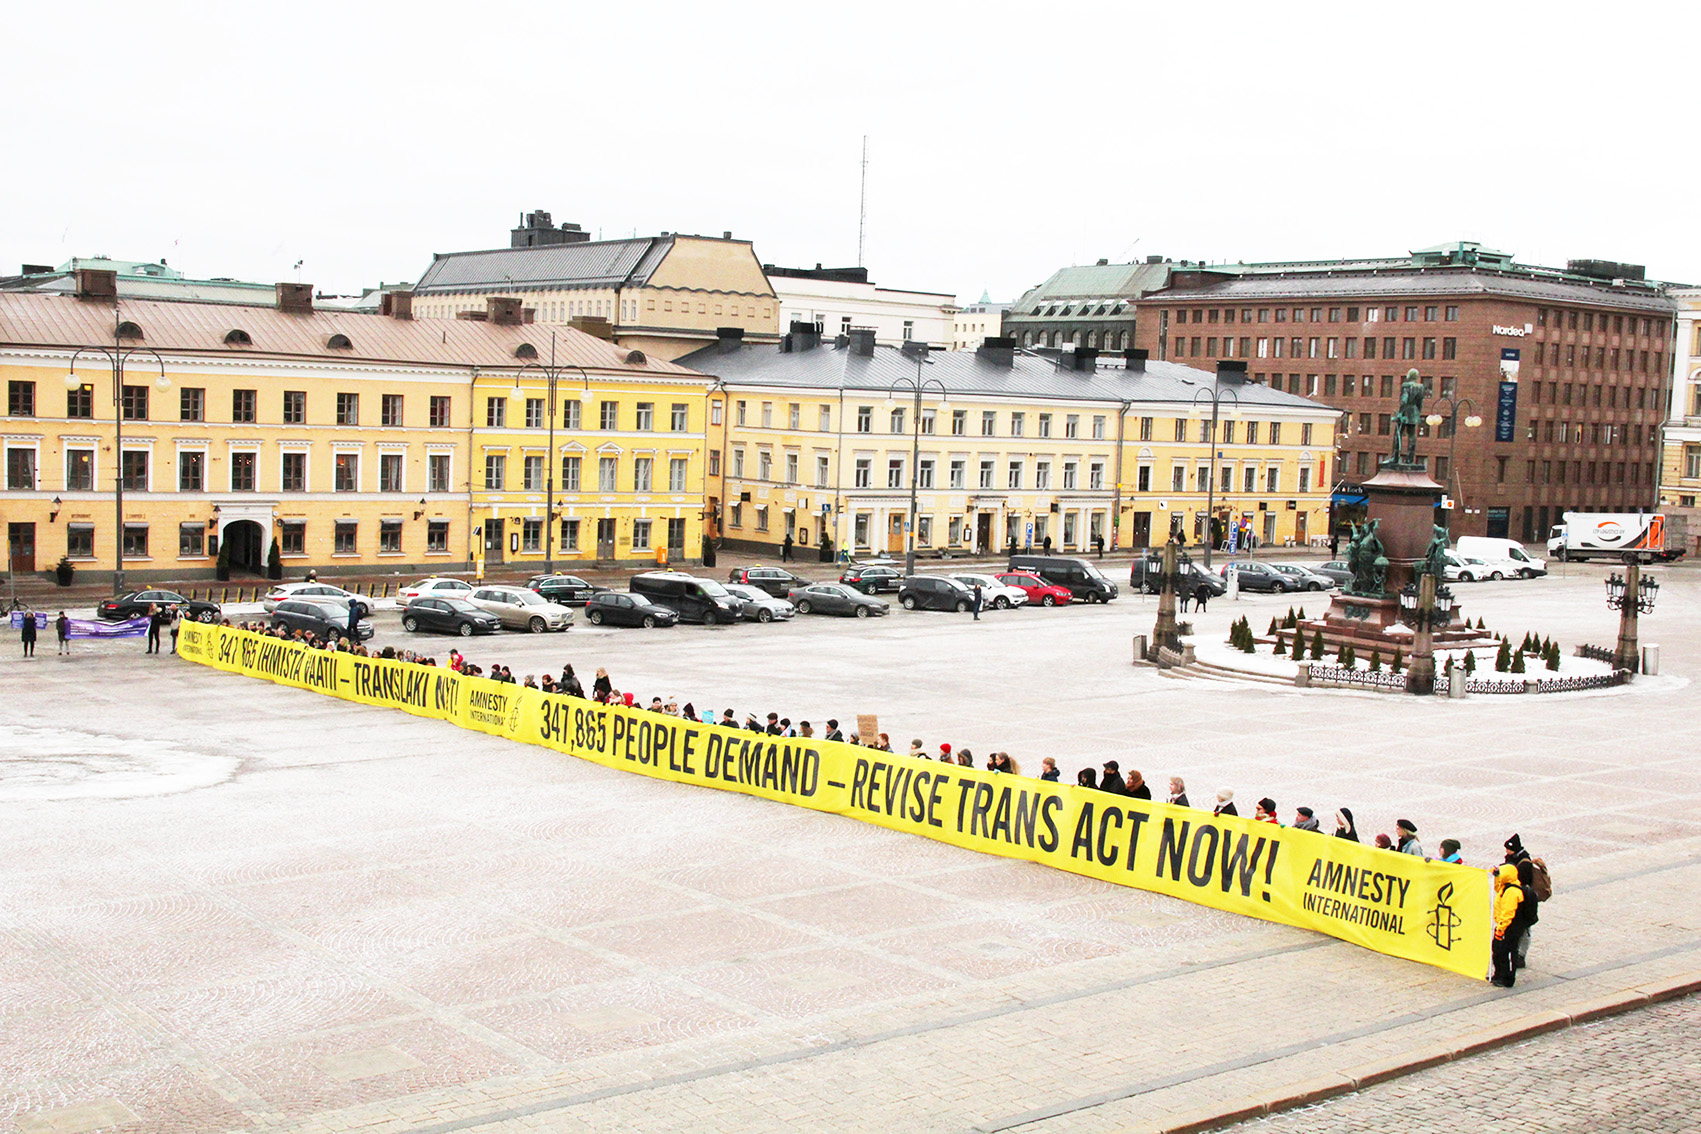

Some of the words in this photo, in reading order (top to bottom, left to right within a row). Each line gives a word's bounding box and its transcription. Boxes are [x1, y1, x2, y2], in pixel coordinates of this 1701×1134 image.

[1492, 325, 1525, 337] Nordea
[218, 633, 239, 665] 347
[257, 642, 308, 680] IHMISTÄ
[304, 654, 338, 691] VAATII
[353, 662, 430, 708] TRANSLAKI
[435, 675, 460, 716] NYT!
[469, 690, 508, 713] AMNESTY
[540, 699, 608, 753] 347,865
[612, 715, 699, 775] PEOPLE
[704, 733, 820, 797] DEMAND
[850, 758, 950, 828] REVISE
[957, 778, 1063, 853] TRANS
[1070, 801, 1150, 872] ACT
[1155, 817, 1281, 903] NOW!
[1306, 858, 1411, 909] AMNESTY
[1303, 892, 1406, 936] INTERNATIONAL
